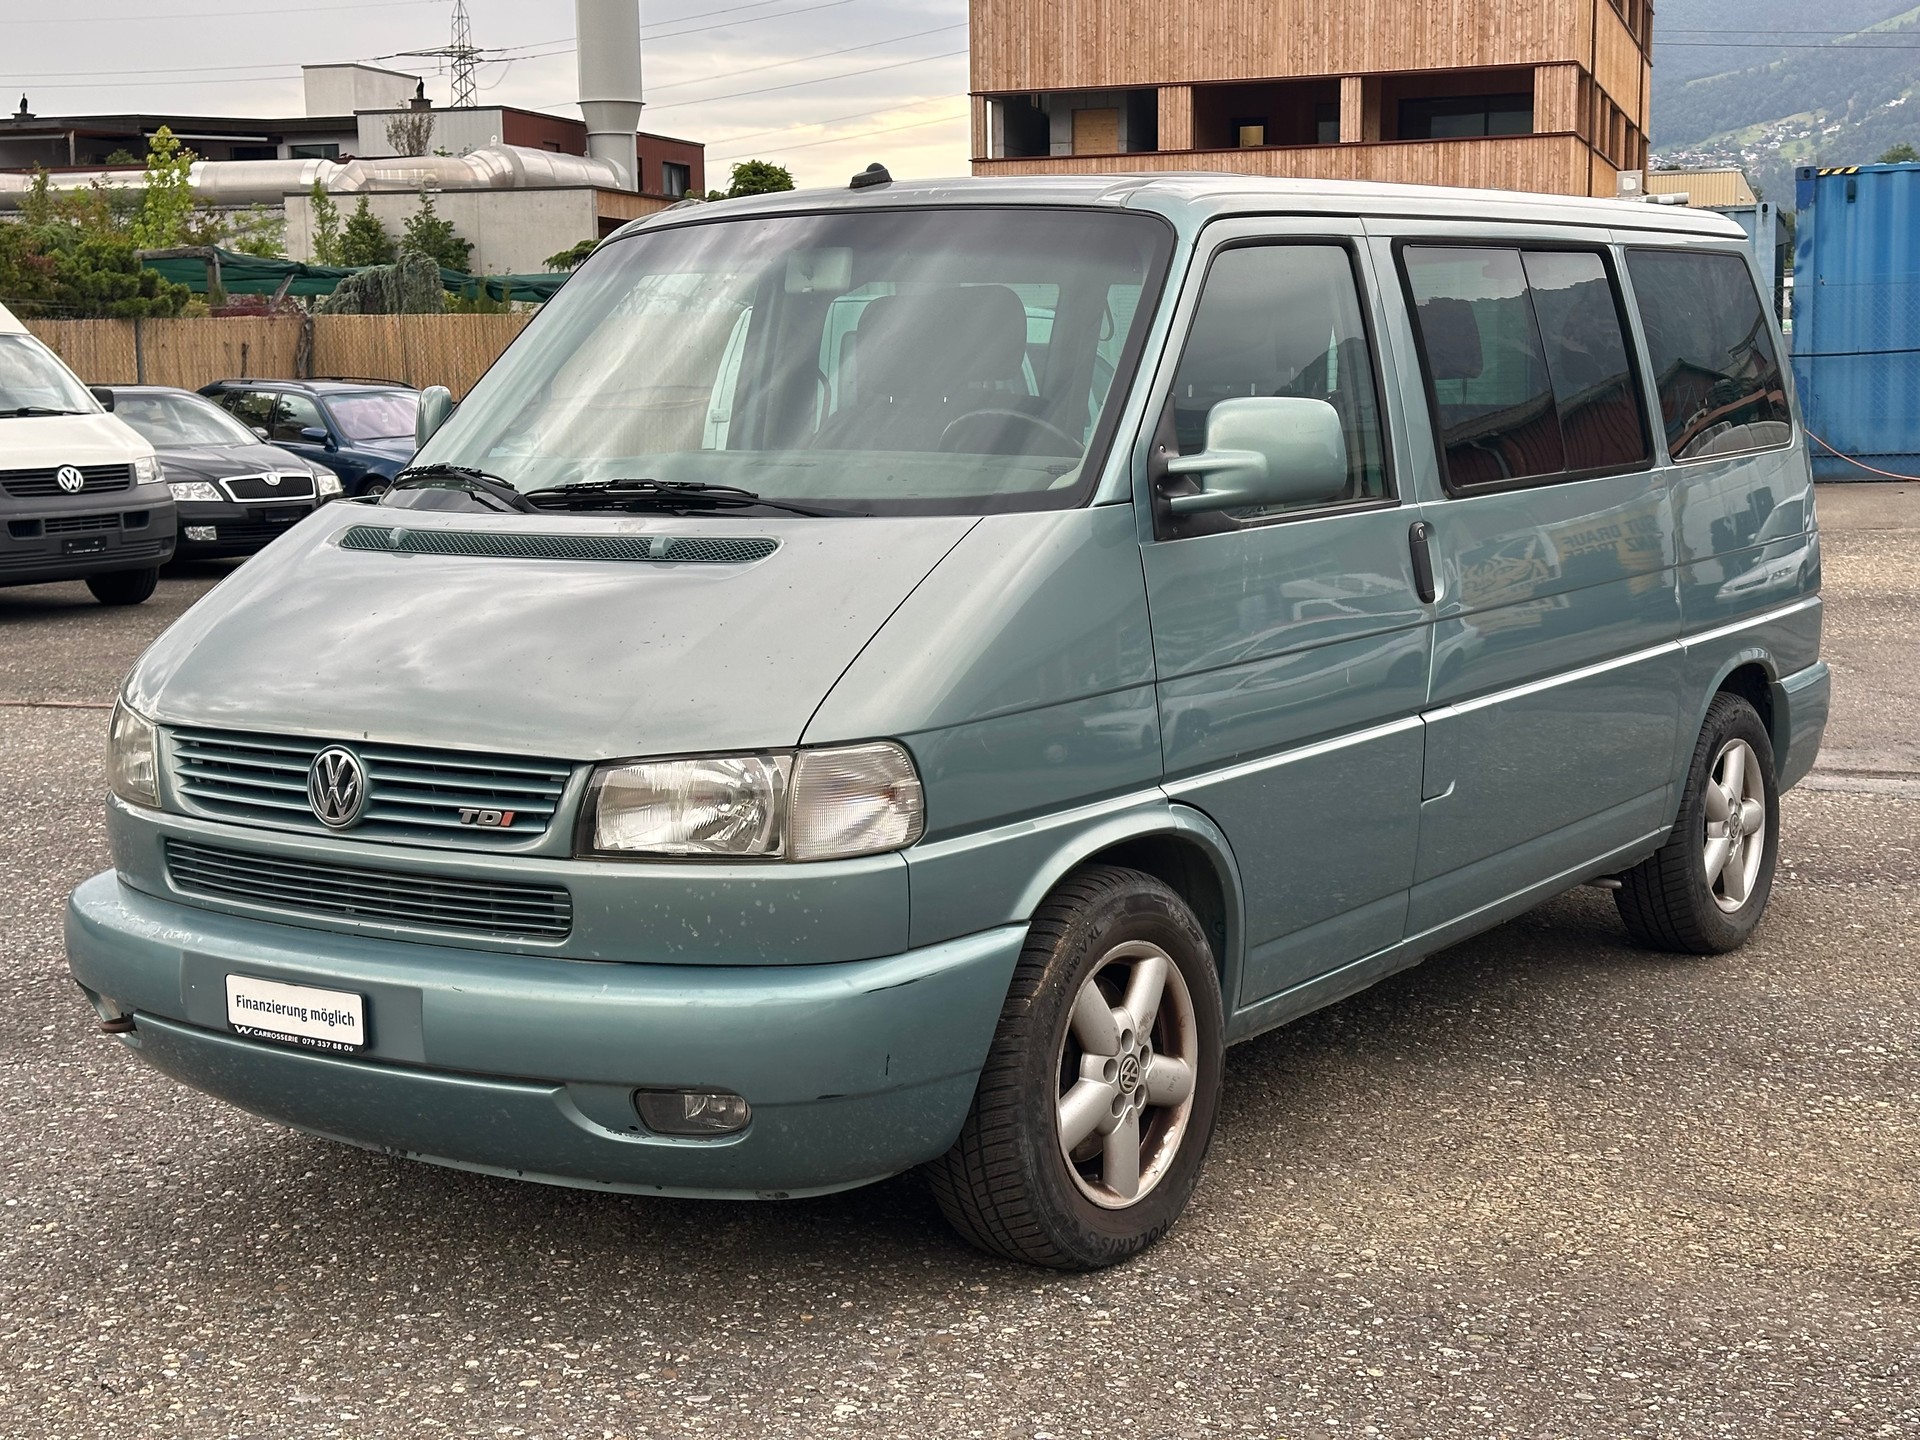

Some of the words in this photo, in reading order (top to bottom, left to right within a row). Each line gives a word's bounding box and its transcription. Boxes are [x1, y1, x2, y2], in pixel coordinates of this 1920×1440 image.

[58, 467, 83, 492] VW
[310, 748, 363, 825] VW
[458, 807, 515, 827] TDI
[236, 994, 308, 1022] Finanzierung
[310, 1007, 355, 1027] möglich
[253, 1029, 298, 1043] CARROSSERIE
[302, 1037, 316, 1046] 079
[317, 1040, 331, 1048] 337
[343, 1044, 354, 1052] 06
[1100, 1219, 1168, 1256] POLARIS
